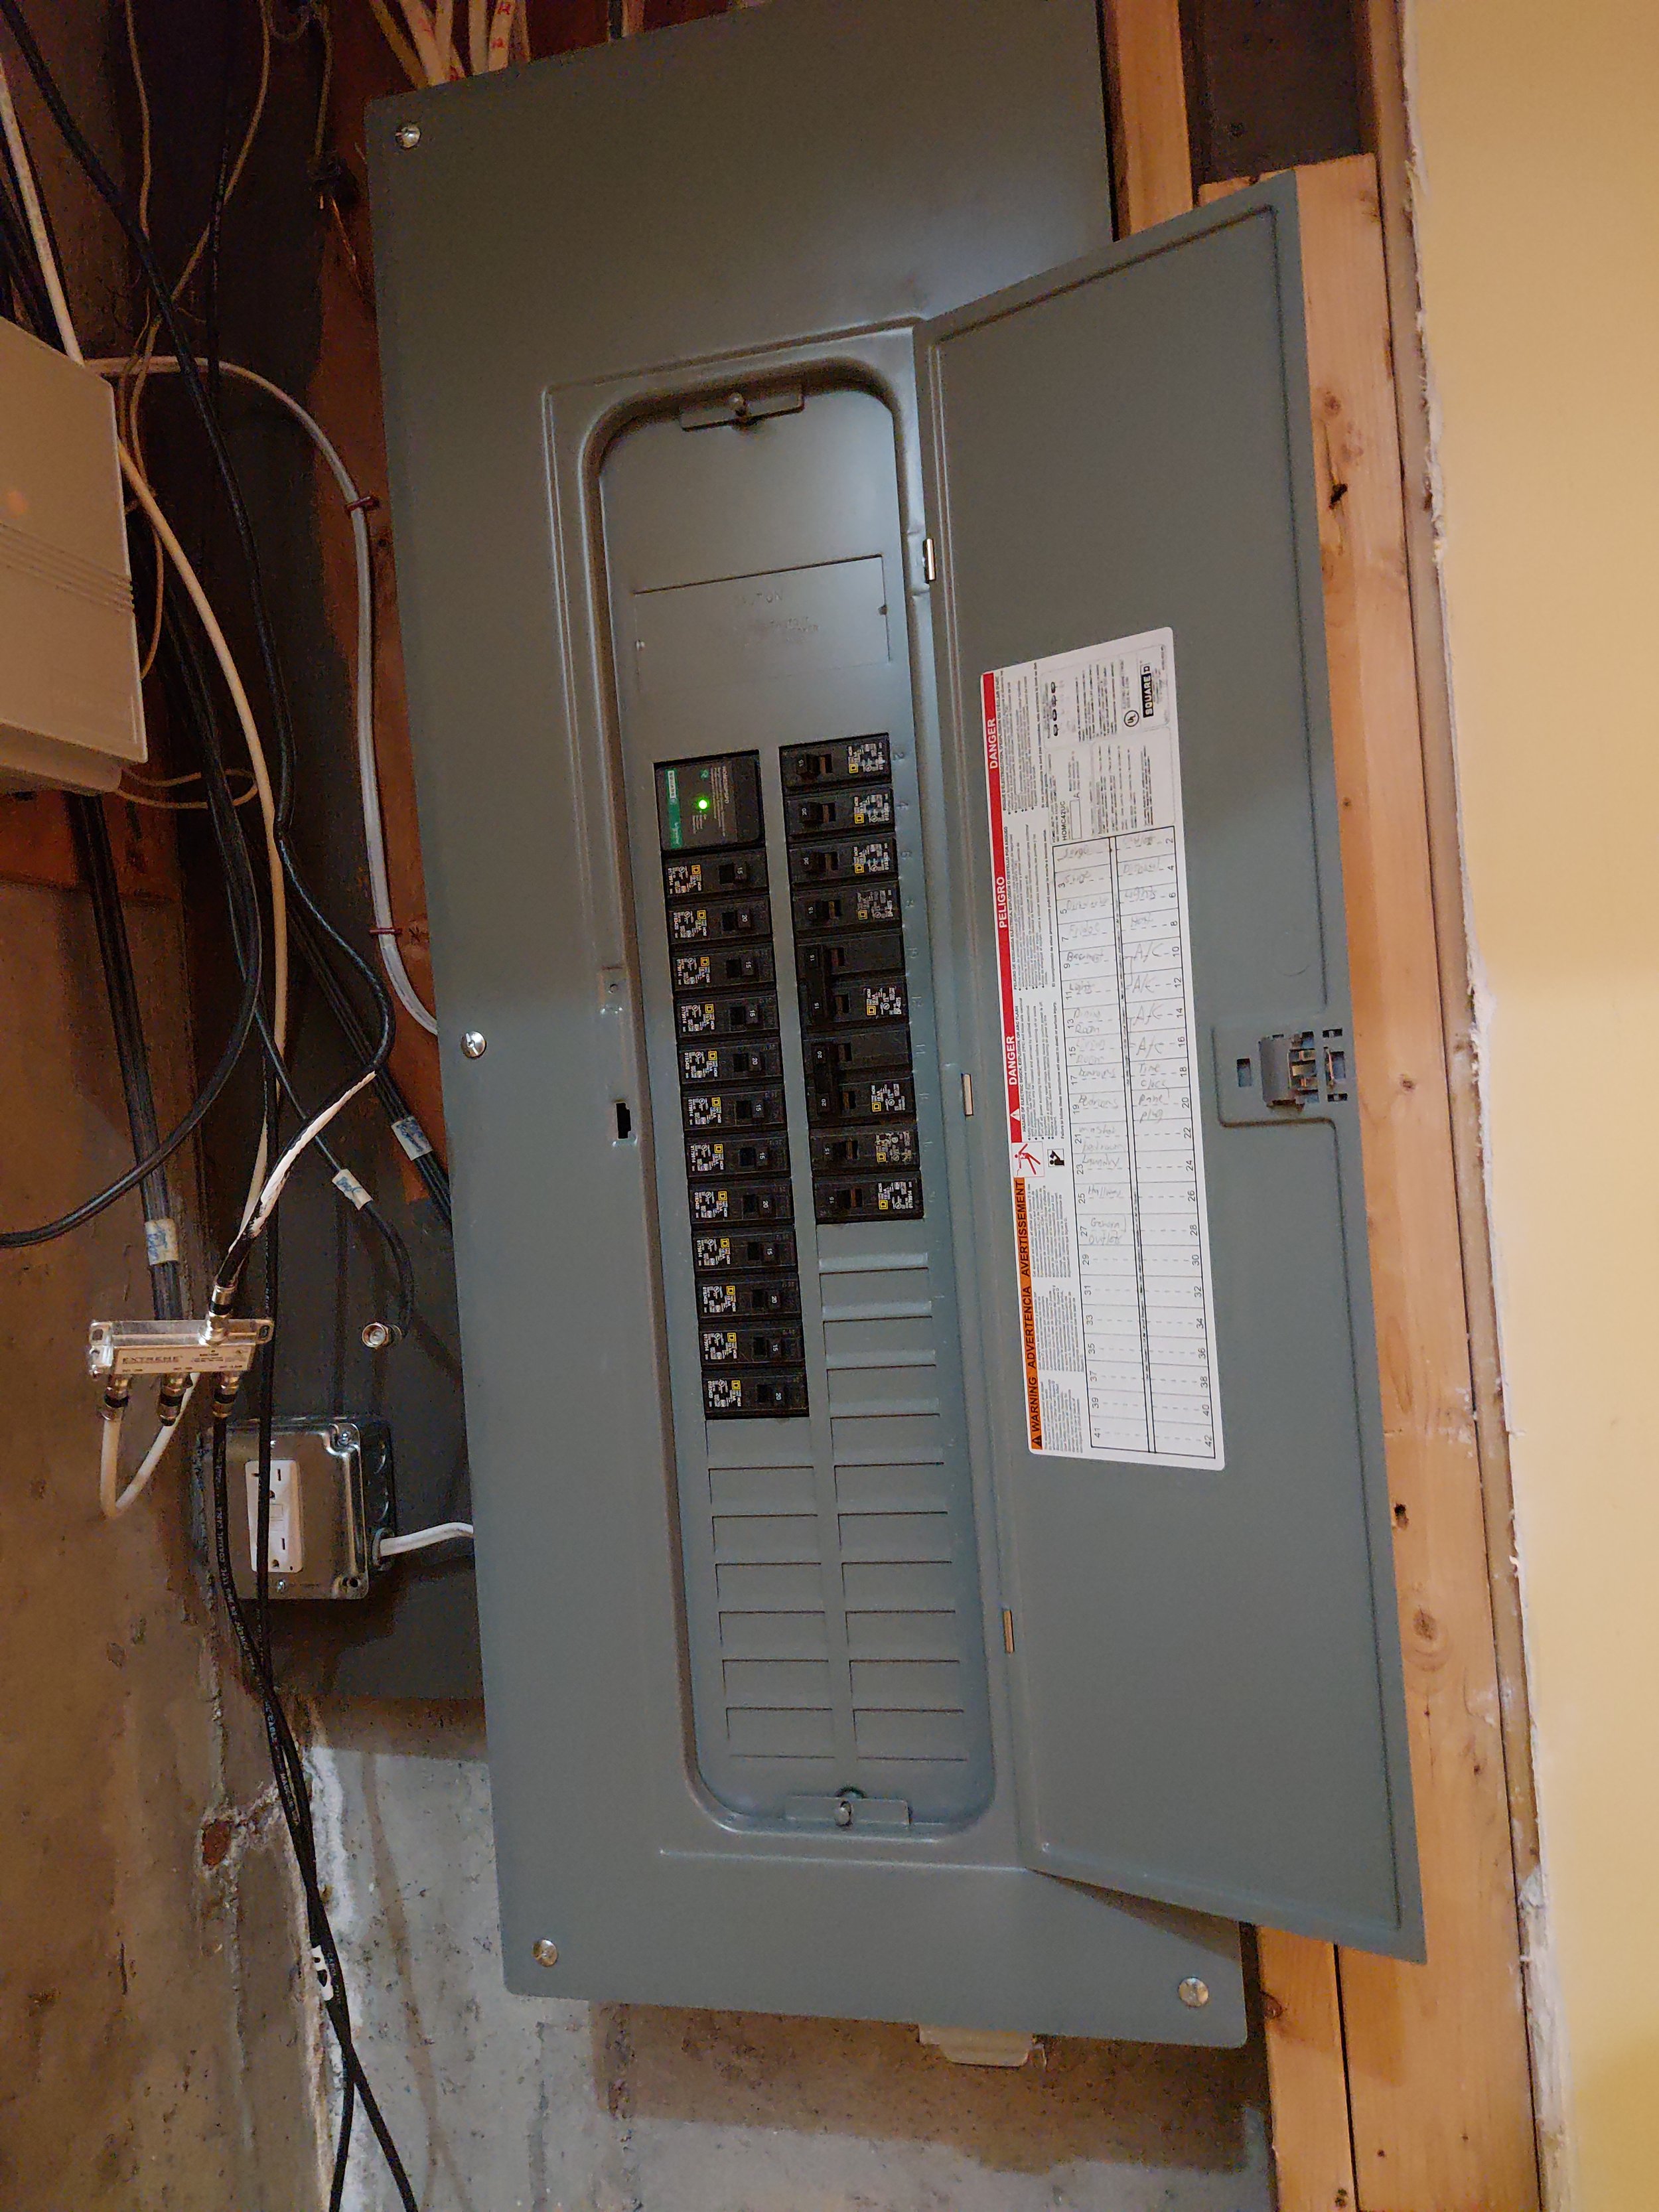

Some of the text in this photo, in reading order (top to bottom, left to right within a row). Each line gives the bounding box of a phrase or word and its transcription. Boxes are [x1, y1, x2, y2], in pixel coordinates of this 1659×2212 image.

[1143, 675, 1153, 715] SQUARE
[987, 717, 998, 769] DANGER
[997, 877, 1007, 928] PELIGRO
[1173, 946, 1179, 957] 10
[1174, 978, 1181, 988] 12
[1065, 991, 1072, 1000] 11
[1176, 1008, 1183, 1018] 14
[1067, 1019, 1074, 1029] 13
[1178, 1037, 1185, 1047] 16
[1069, 1047, 1076, 1057] 15
[1006, 1036, 1017, 1085] DANGER
[1180, 1067, 1187, 1076] 18
[1071, 1076, 1078, 1085] 17
[1182, 1097, 1189, 1108] 20
[1073, 1104, 1080, 1114] 19
[1075, 1134, 1082, 1143] 21
[1184, 1128, 1191, 1138] 22
[1076, 1164, 1084, 1175] 23
[1186, 1160, 1193, 1171] 24
[1078, 1193, 1085, 1204] 25
[1188, 1191, 1195, 1201] 26
[1015, 1180, 1029, 1277] AVERTISSEMENT
[1080, 1226, 1088, 1236] 27
[1190, 1224, 1198, 1236] 28
[1082, 1254, 1089, 1266] 29
[1191, 1254, 1199, 1266] 30
[1084, 1286, 1091, 1295] 31
[1194, 1286, 1201, 1297] 32
[1086, 1315, 1093, 1325] 33
[1196, 1318, 1203, 1329] 34
[1022, 1286, 1035, 1368] ADVERTENCIA
[1088, 1343, 1096, 1354] 35
[1198, 1348, 1206, 1359] 36
[1090, 1370, 1097, 1382] 37
[1200, 1376, 1208, 1388] 38
[1029, 1376, 1040, 1432] WARNING
[1092, 1397, 1099, 1408] 39
[1202, 1404, 1209, 1416] 40
[1094, 1428, 1101, 1438] 41
[1204, 1435, 1212, 1447] 42
